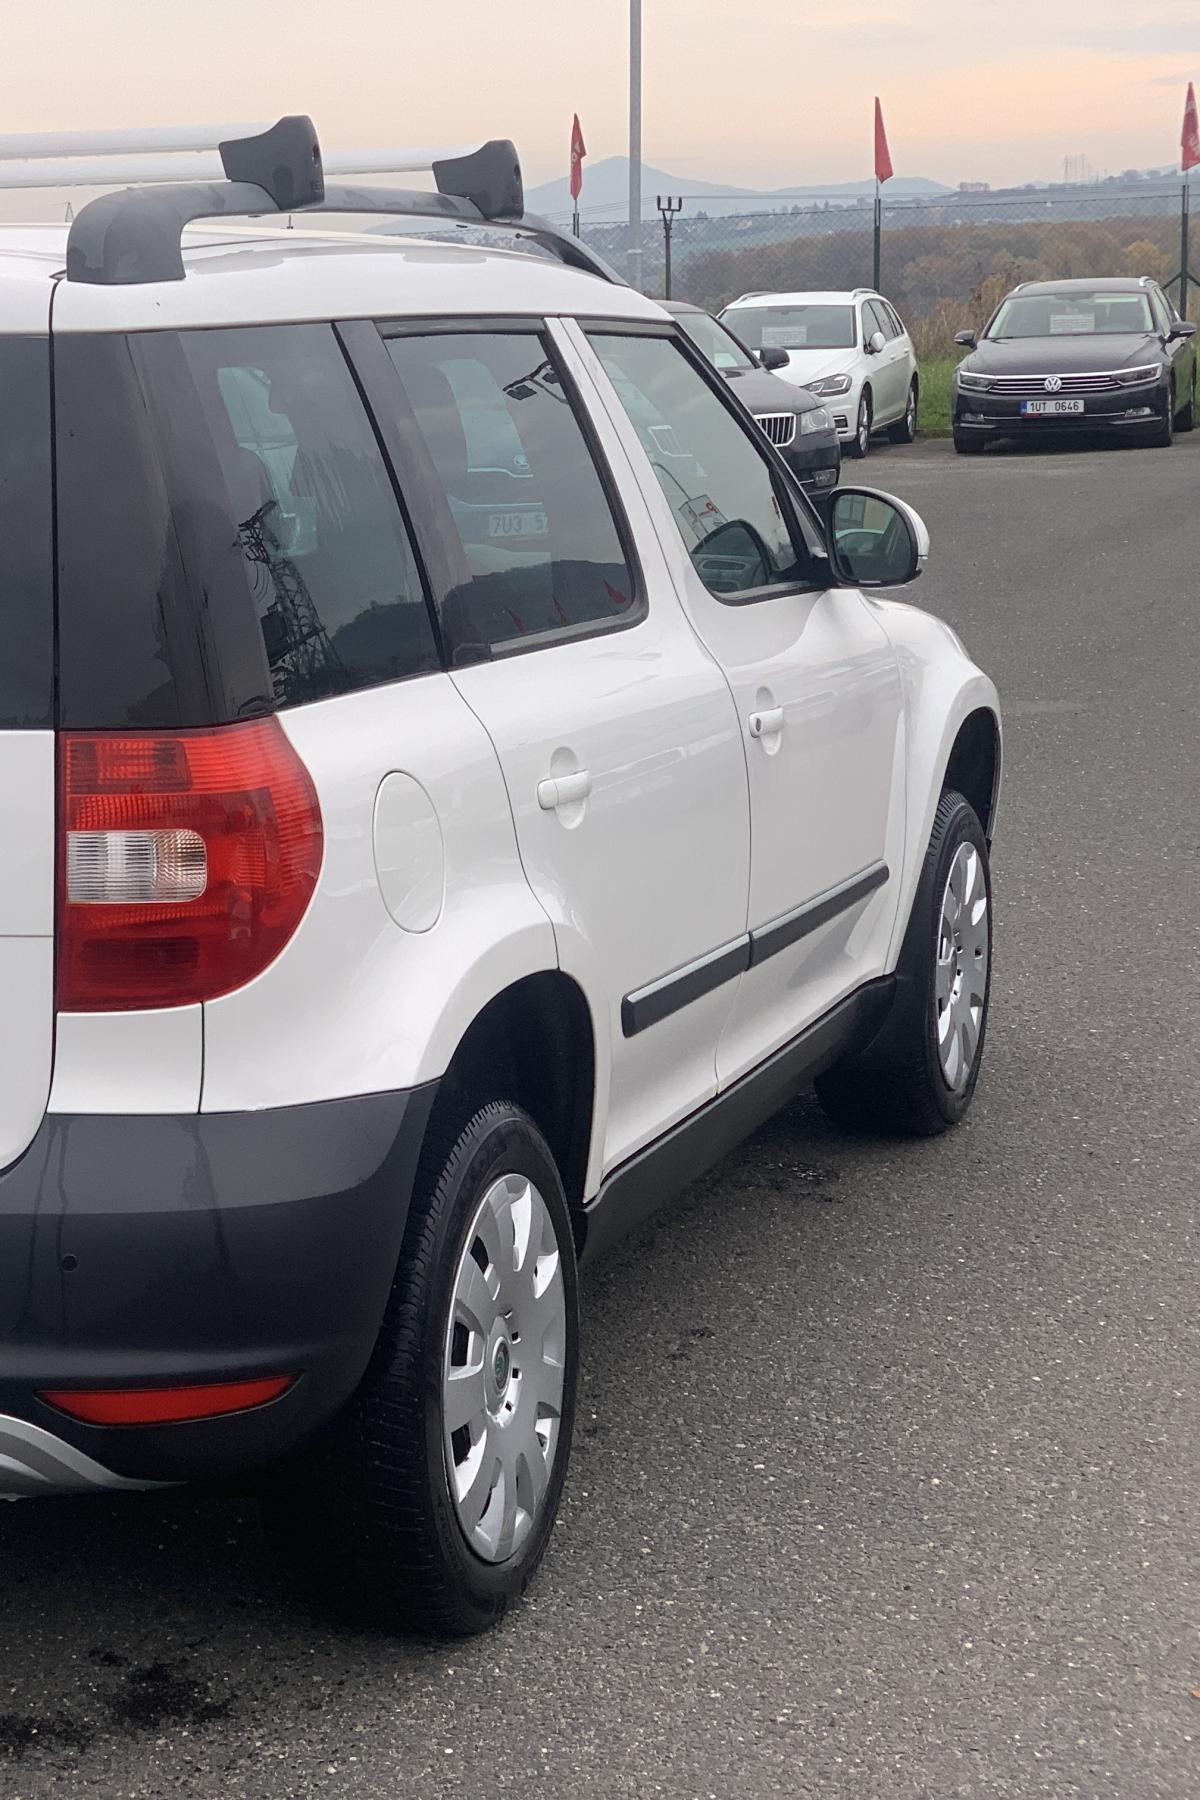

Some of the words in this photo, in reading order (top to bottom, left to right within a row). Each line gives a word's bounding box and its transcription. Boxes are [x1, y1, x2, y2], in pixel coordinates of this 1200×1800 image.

[1030, 402, 1046, 412] 1UT
[1055, 401, 1079, 411] 0646
[492, 515, 522, 534] 7U3
